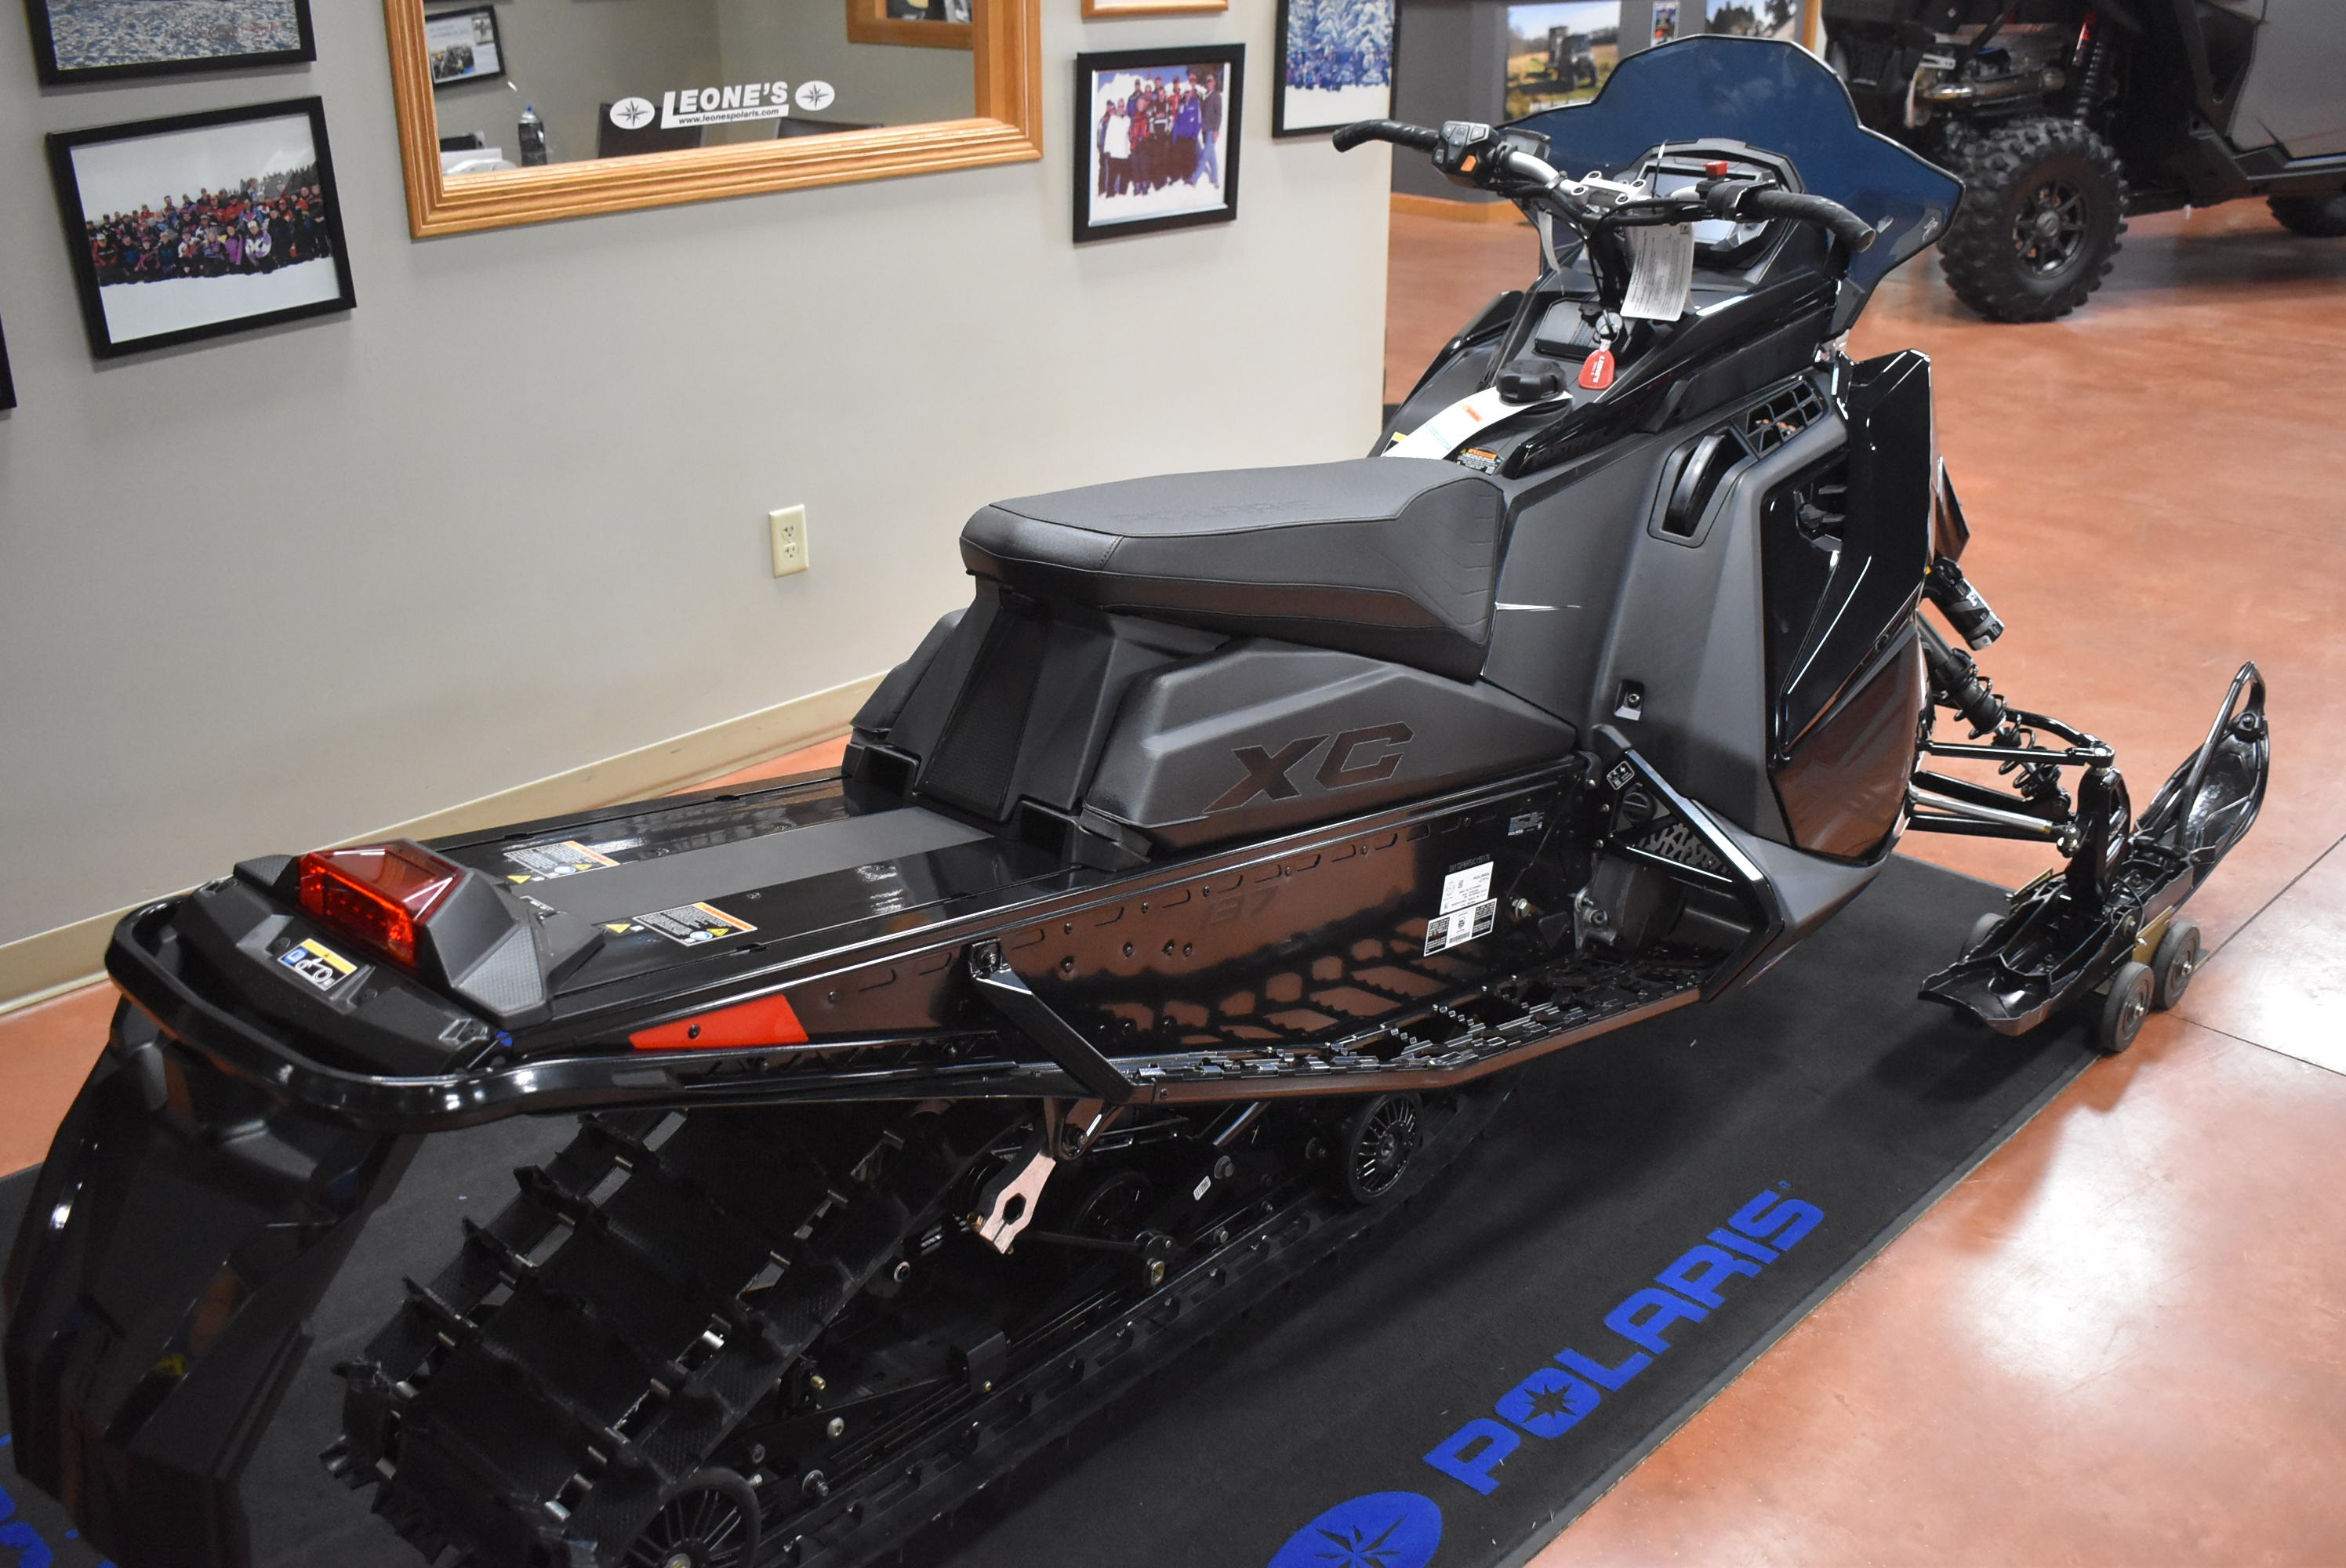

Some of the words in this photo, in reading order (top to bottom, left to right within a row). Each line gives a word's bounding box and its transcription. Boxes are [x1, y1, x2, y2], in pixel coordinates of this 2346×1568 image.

[660, 82, 789, 129] LEONE'S
[678, 107, 779, 125] www.leonespolaris.com
[1202, 721, 1415, 815] XC
[1422, 1187, 1825, 1495] POLARIS
